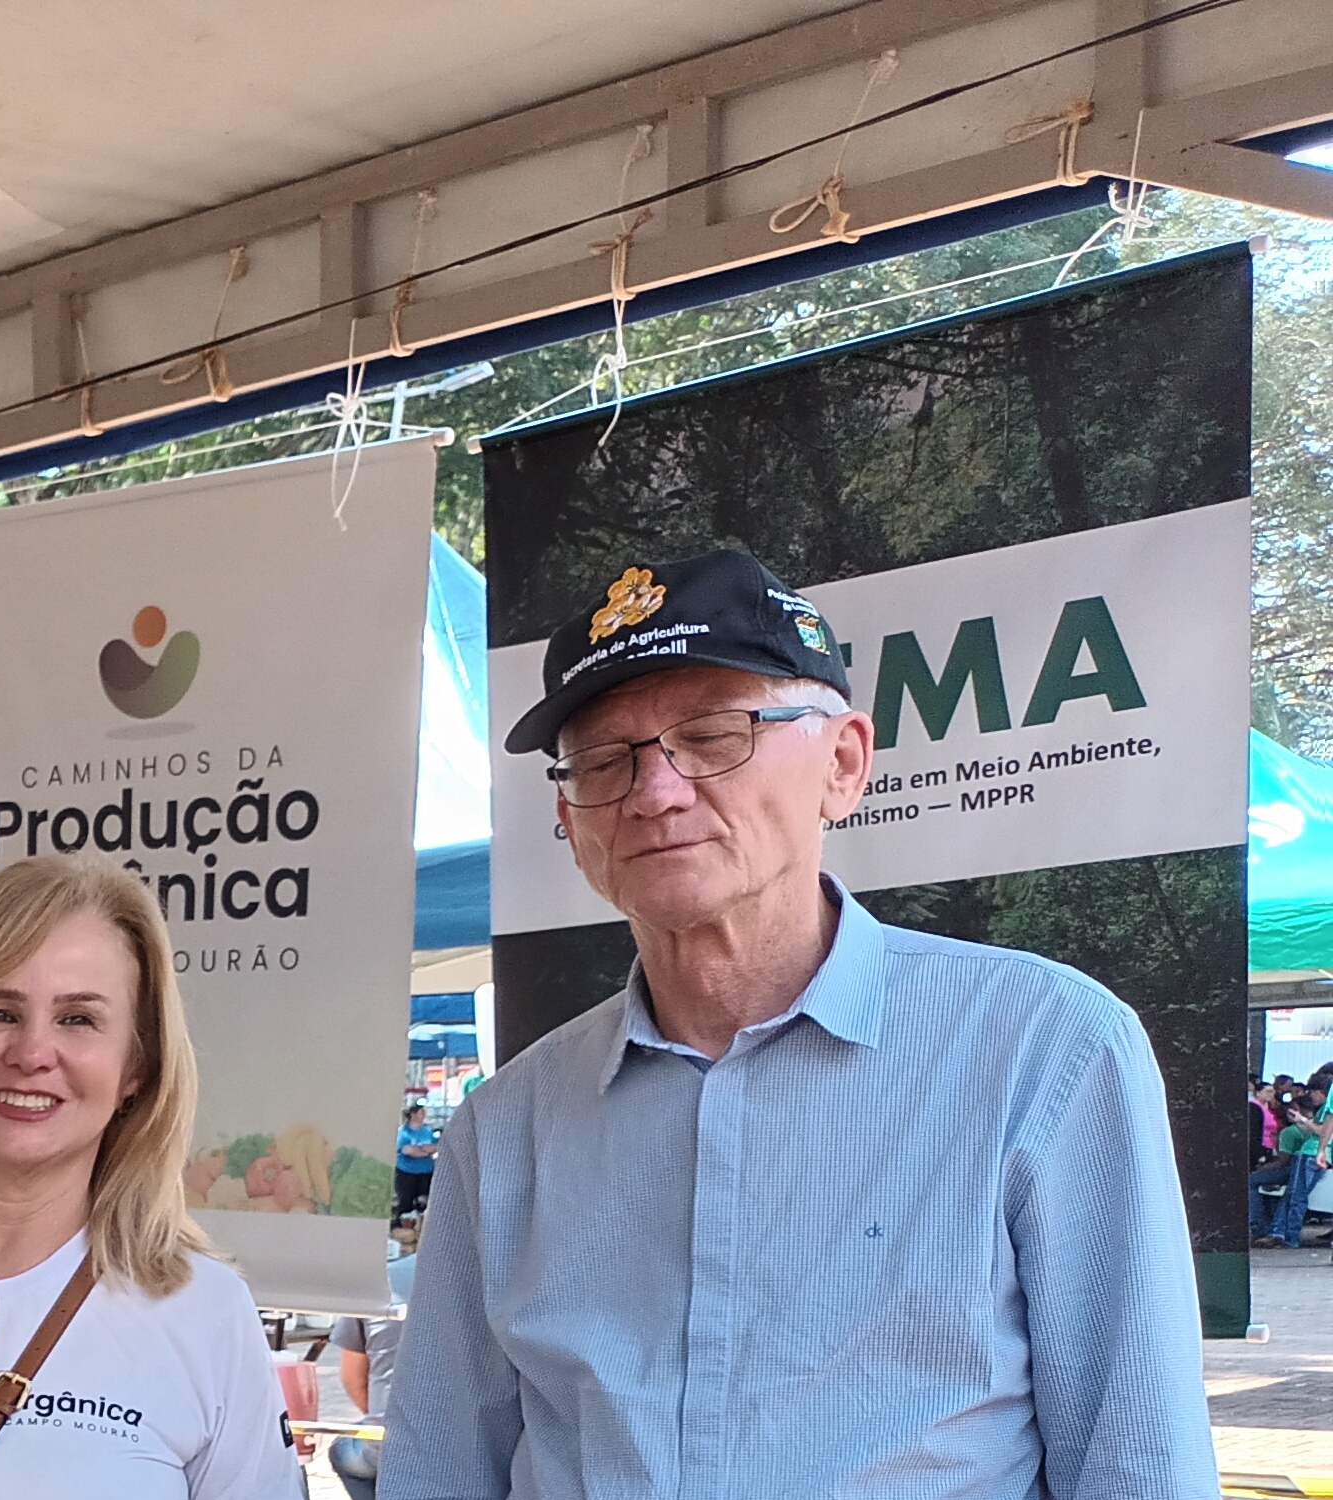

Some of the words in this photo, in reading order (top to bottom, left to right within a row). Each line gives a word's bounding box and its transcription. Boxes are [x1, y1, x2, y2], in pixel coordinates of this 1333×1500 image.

[609, 640, 626, 655] de
[627, 623, 711, 647] Agricultura
[21, 751, 212, 788] CAMINHOS
[238, 745, 284, 771] DA
[910, 767, 948, 790] em
[955, 756, 1020, 783] Meio
[1027, 737, 1162, 773] Ambiente,
[822, 801, 920, 832] anismo
[960, 783, 1036, 813] MPPR
[123, 852, 310, 922] nica
[172, 945, 300, 974] OURÃO
[19, 1390, 144, 1428] rgânica
[4, 1418, 64, 1428] CAMPO
[73, 1422, 141, 1444] MOURÃO
